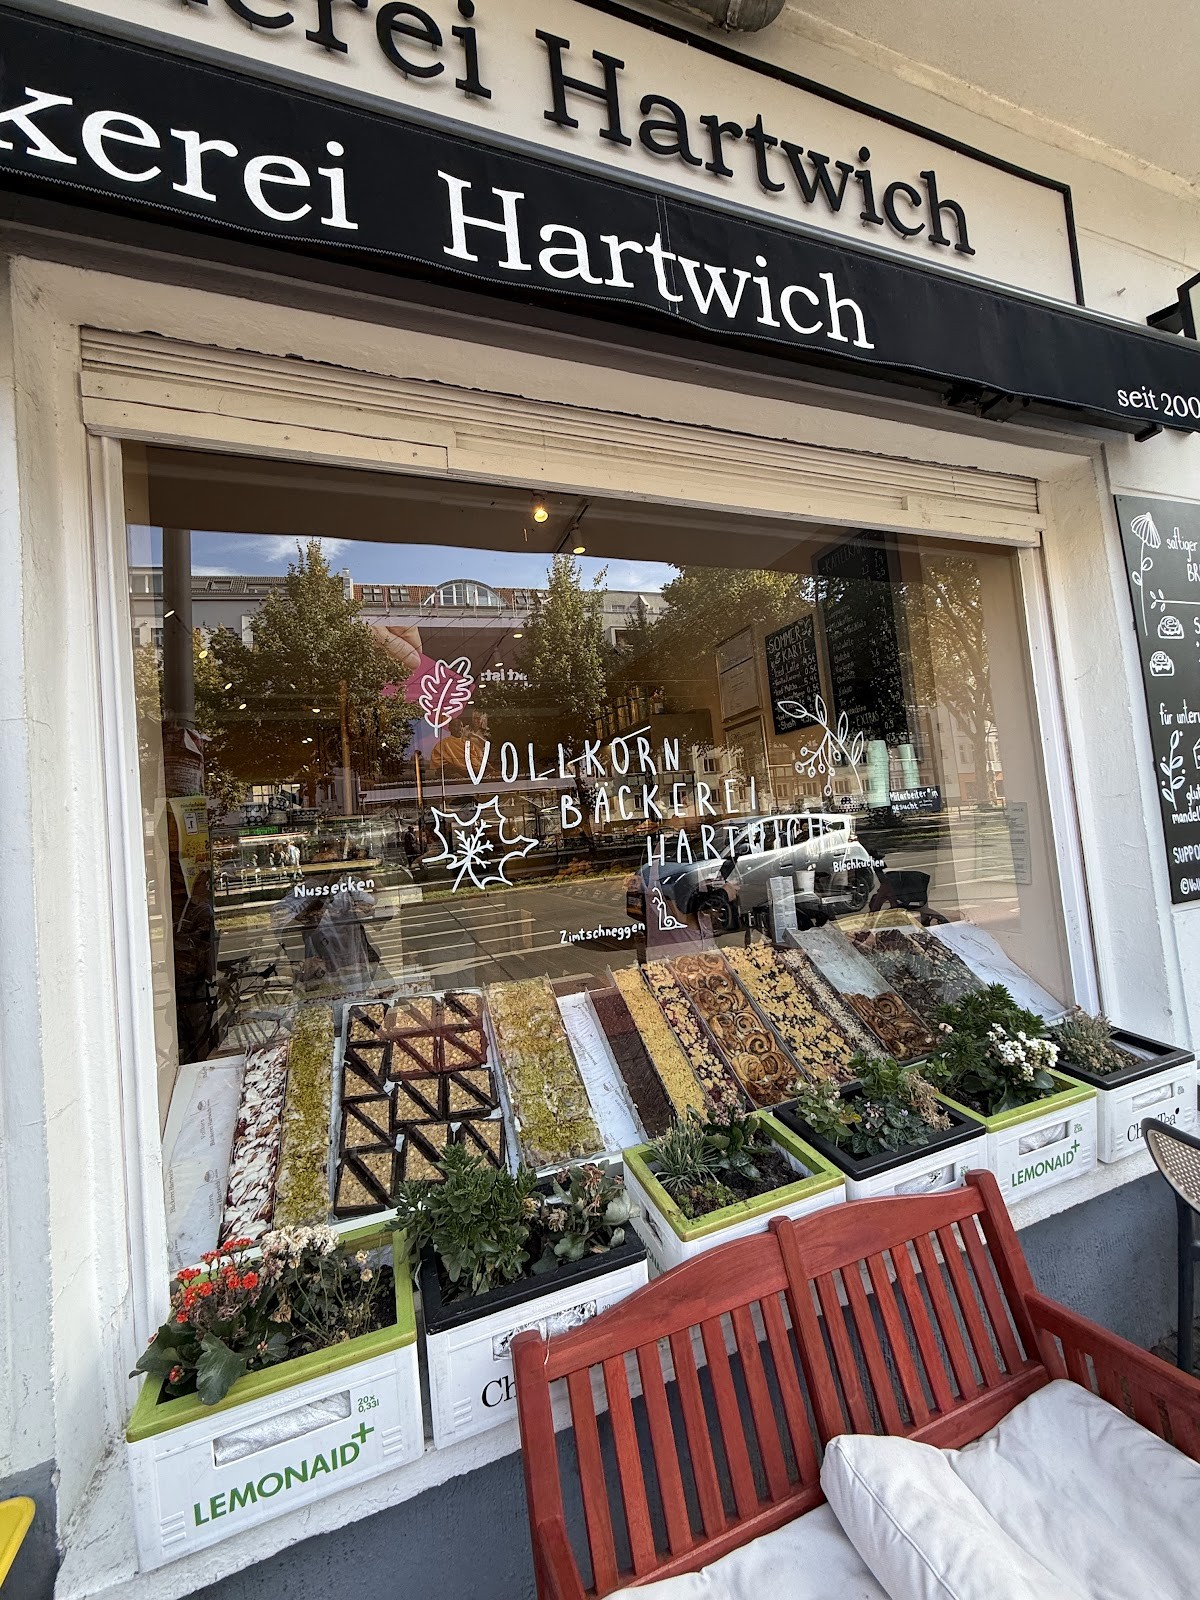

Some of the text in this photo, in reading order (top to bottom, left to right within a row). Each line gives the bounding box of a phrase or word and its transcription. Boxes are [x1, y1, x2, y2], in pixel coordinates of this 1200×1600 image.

[535, 28, 975, 256] Hartwich
[437, 170, 875, 349] Hartwich
[1117, 386, 1158, 411] seit
[1167, 527, 1198, 562] saftiger
[1187, 563, 1200, 582] BR
[782, 638, 811, 662] KARTE
[1176, 699, 1200, 724] unter
[464, 736, 680, 786] VOLLKORN
[560, 776, 756, 830] BÄCKEREI
[892, 802, 919, 813] gesucht
[647, 817, 824, 867] HARTWICH
[1173, 843, 1200, 864] SUPPO
[294, 876, 375, 898] Nussecken
[560, 922, 646, 944] Zimtschneggen
